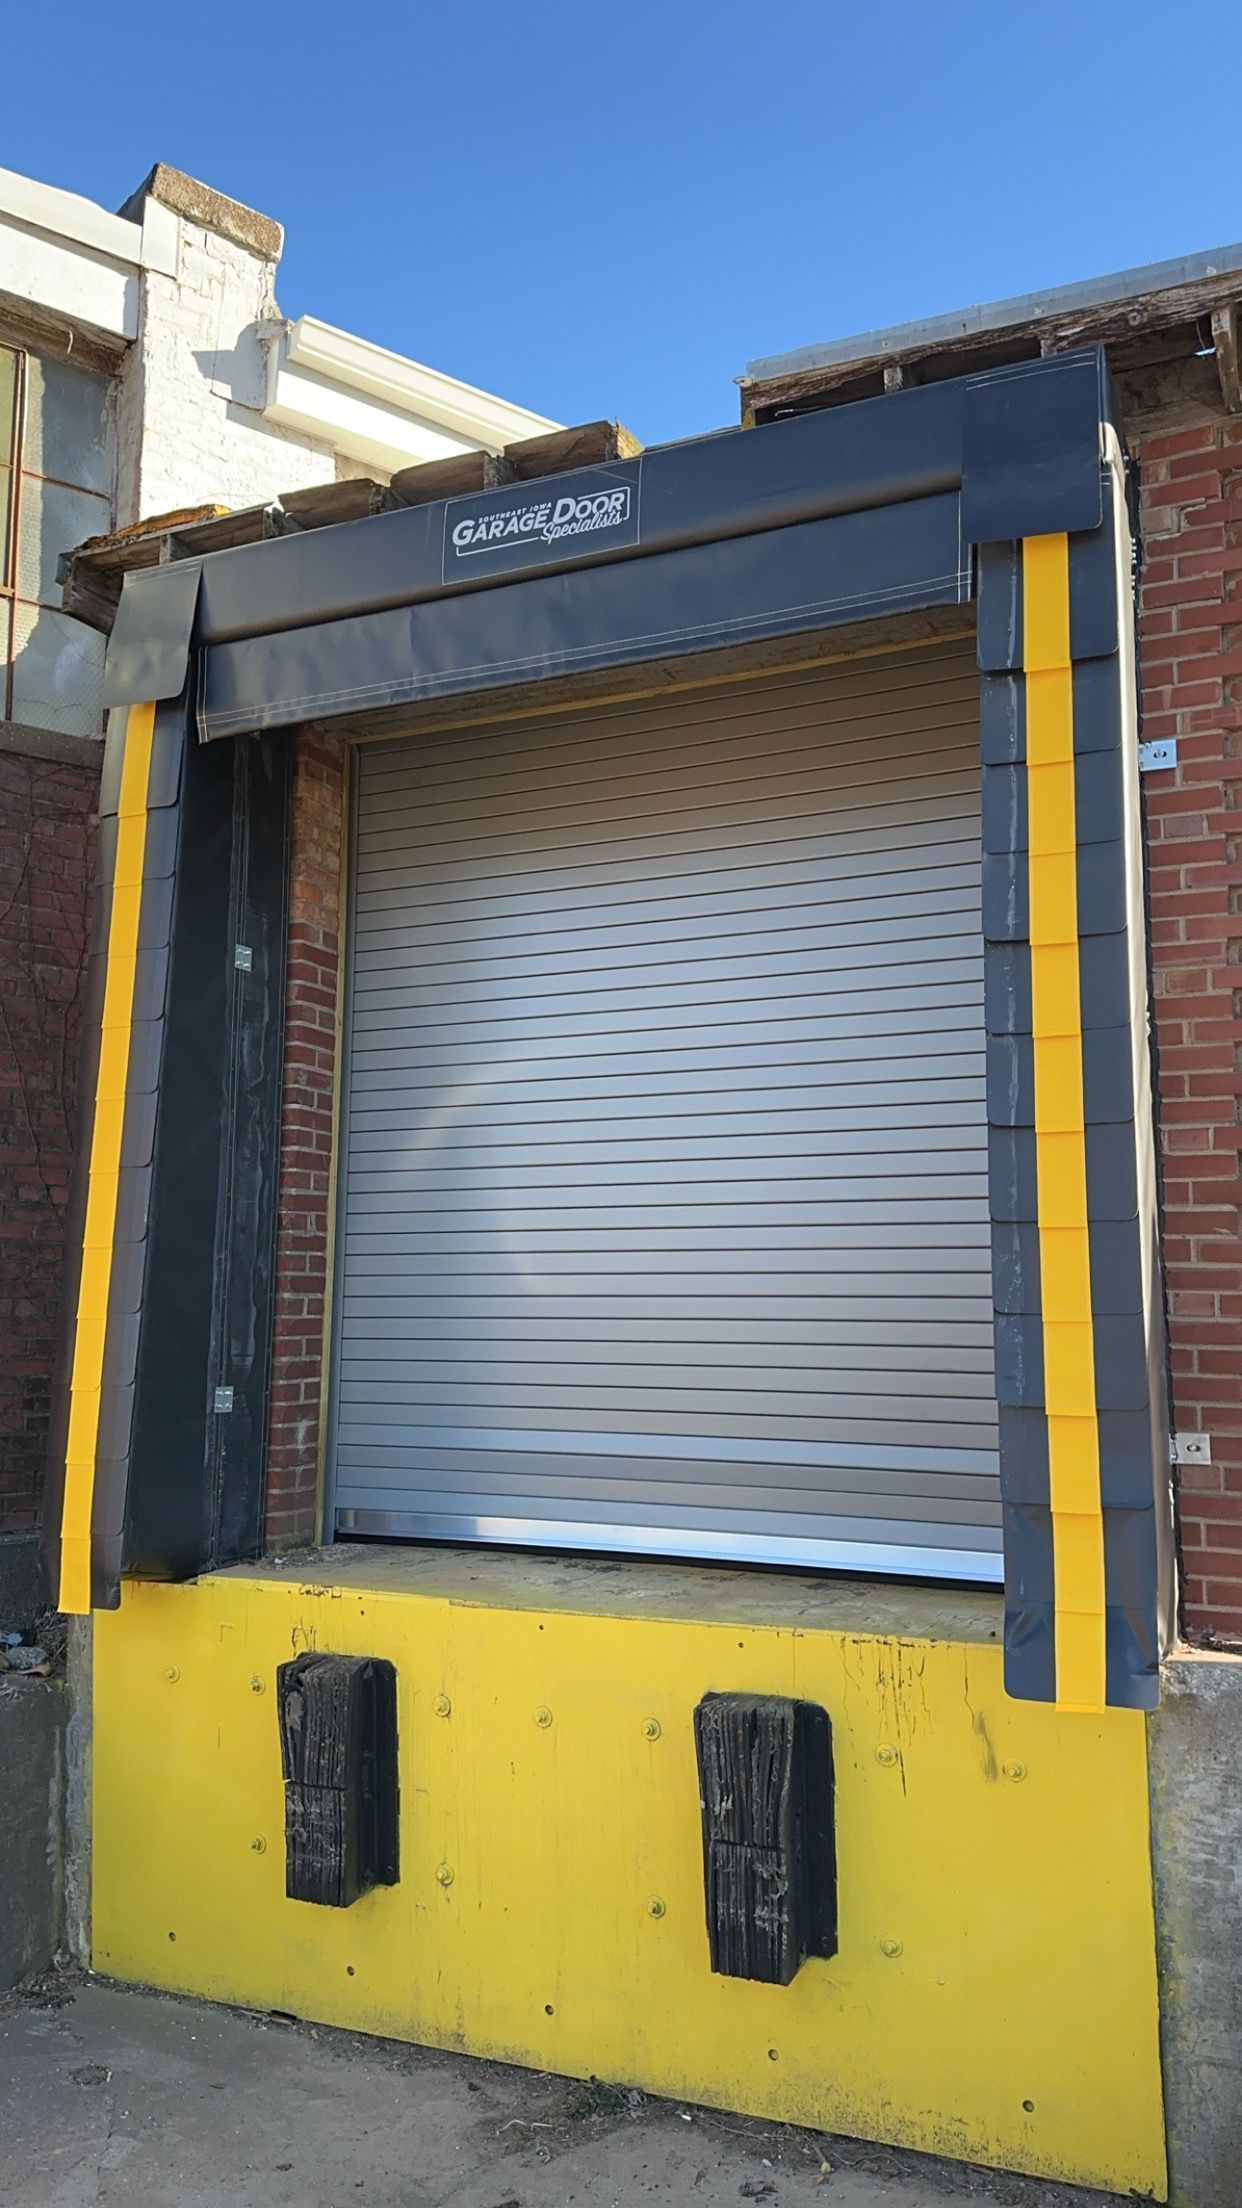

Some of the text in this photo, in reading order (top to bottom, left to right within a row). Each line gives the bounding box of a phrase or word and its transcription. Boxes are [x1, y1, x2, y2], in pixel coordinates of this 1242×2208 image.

[452, 492, 625, 546] GARAGE DOOR
[478, 501, 552, 524] SOUTHEAST IOWA
[540, 509, 623, 545] Specialists
